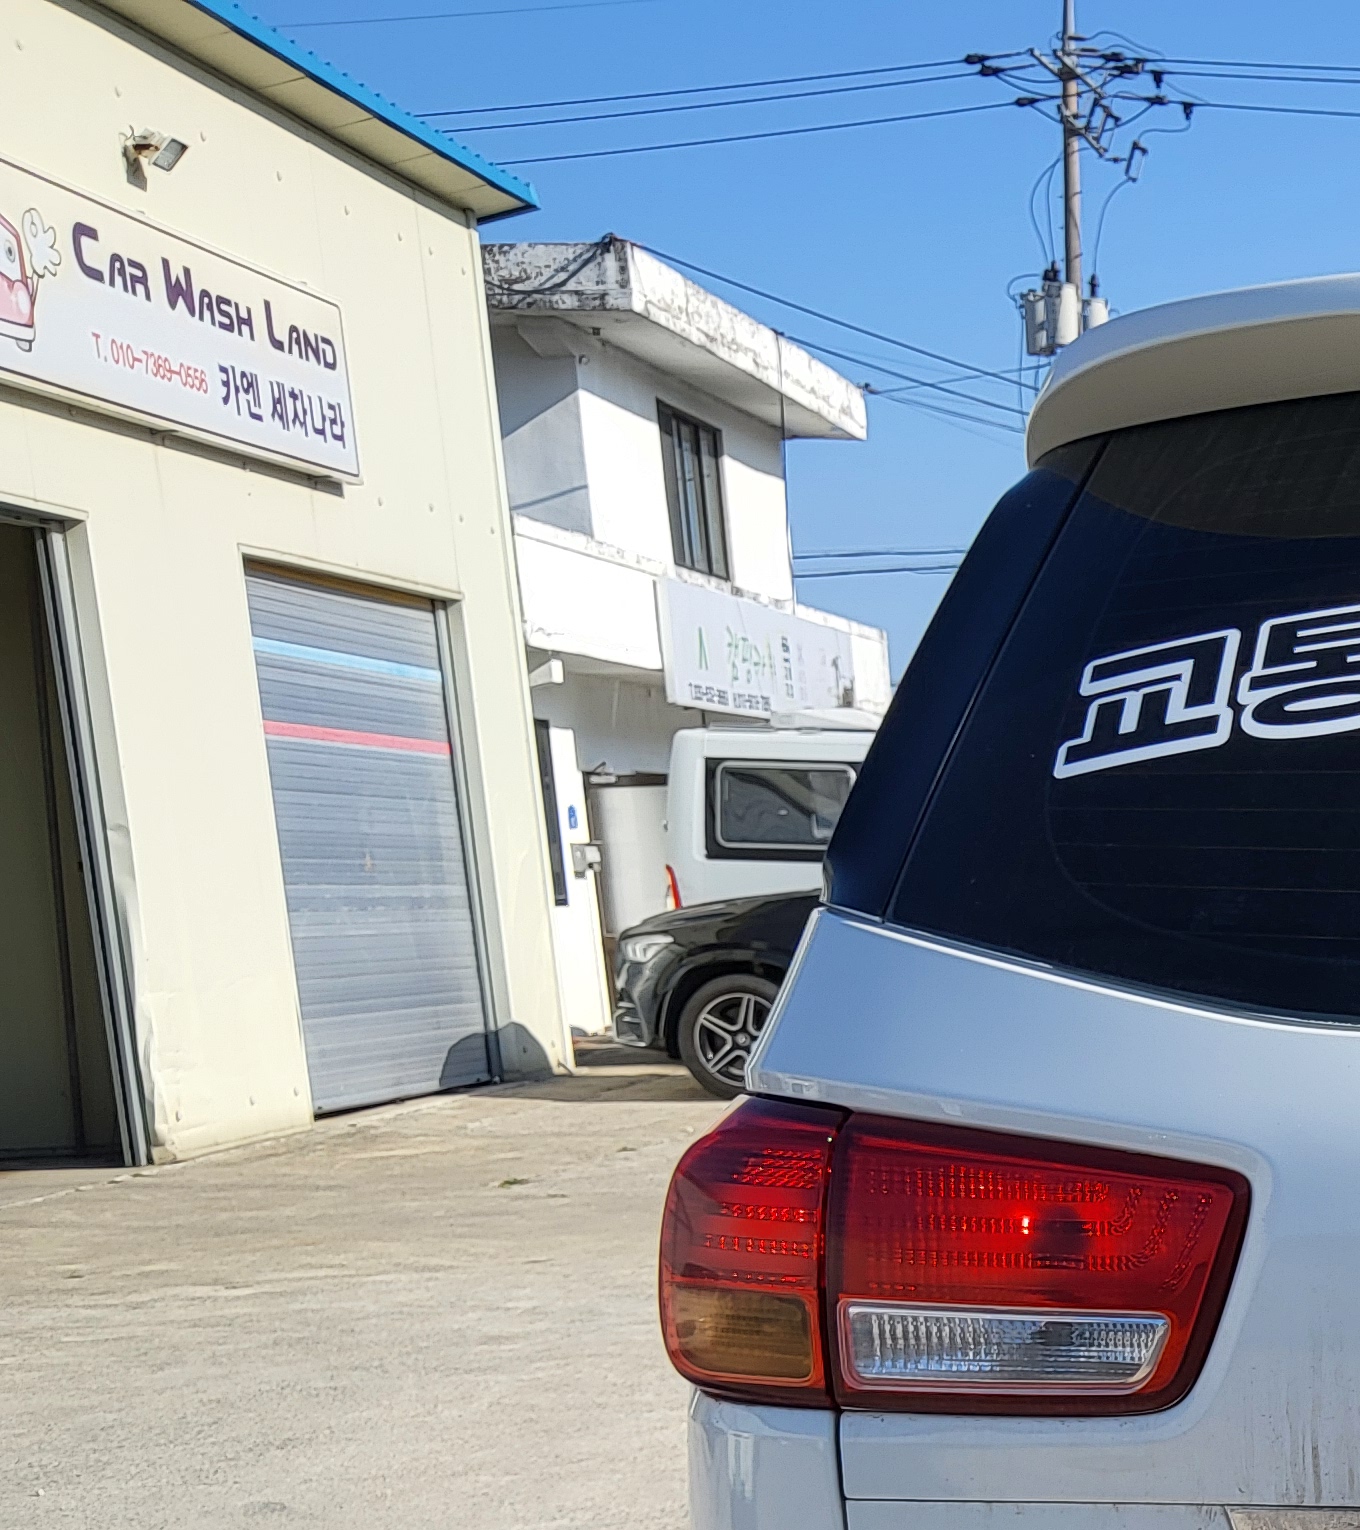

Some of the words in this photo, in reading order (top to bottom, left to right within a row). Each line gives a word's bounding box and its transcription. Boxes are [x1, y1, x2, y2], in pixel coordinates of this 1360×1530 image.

[72, 222, 151, 302] CAR
[161, 257, 255, 341] WASH
[263, 299, 338, 371] LAND
[110, 338, 209, 395] 010-7369-0556
[218, 363, 264, 423] 카엔
[268, 381, 346, 449] 세차나라
